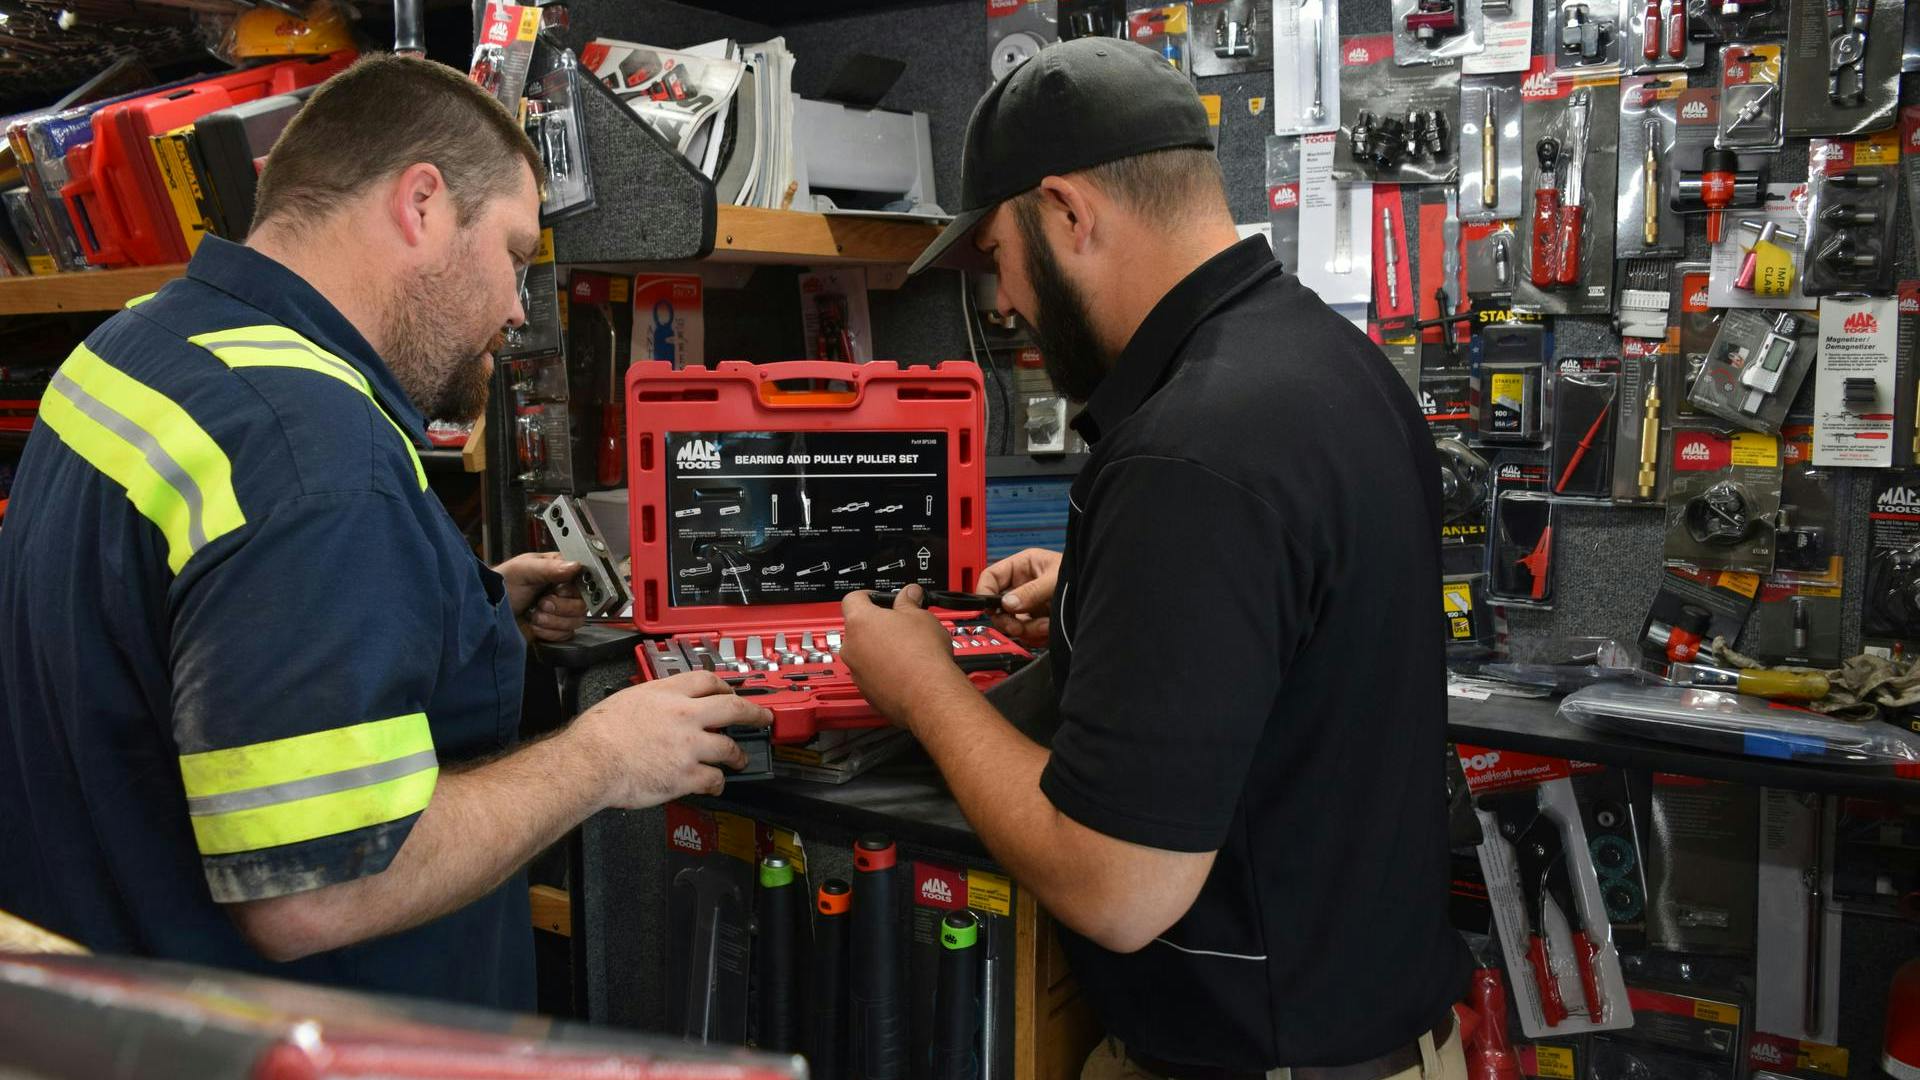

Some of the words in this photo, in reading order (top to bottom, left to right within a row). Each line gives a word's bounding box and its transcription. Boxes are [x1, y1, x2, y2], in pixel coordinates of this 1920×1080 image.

[1523, 89, 1558, 97] TOOLS
[1682, 101, 1708, 113] MAC
[1479, 309, 1544, 322] STANLEY
[1844, 312, 1877, 327] MAC
[1560, 359, 1580, 369] MAC
[677, 440, 720, 460] MAC
[1682, 442, 1710, 454] MAC
[676, 461, 721, 470] TOOLS
[735, 455, 784, 464] BEARING
[786, 455, 811, 464] AND
[814, 455, 854, 464] PULLEY
[857, 455, 896, 464] PULLER
[899, 455, 919, 464] SET
[1502, 464, 1520, 474] MAC
[1877, 487, 1920, 506] MAC
[1876, 505, 1920, 514] TOOLS
[1442, 526, 1486, 536] ANLEY
[1460, 752, 1500, 773] POP
[1466, 770, 1512, 786] wivelHead
[674, 825, 702, 844] MAC
[674, 840, 702, 851] TOOLS
[922, 879, 952, 896] MAC
[922, 892, 952, 903] TOOLS
